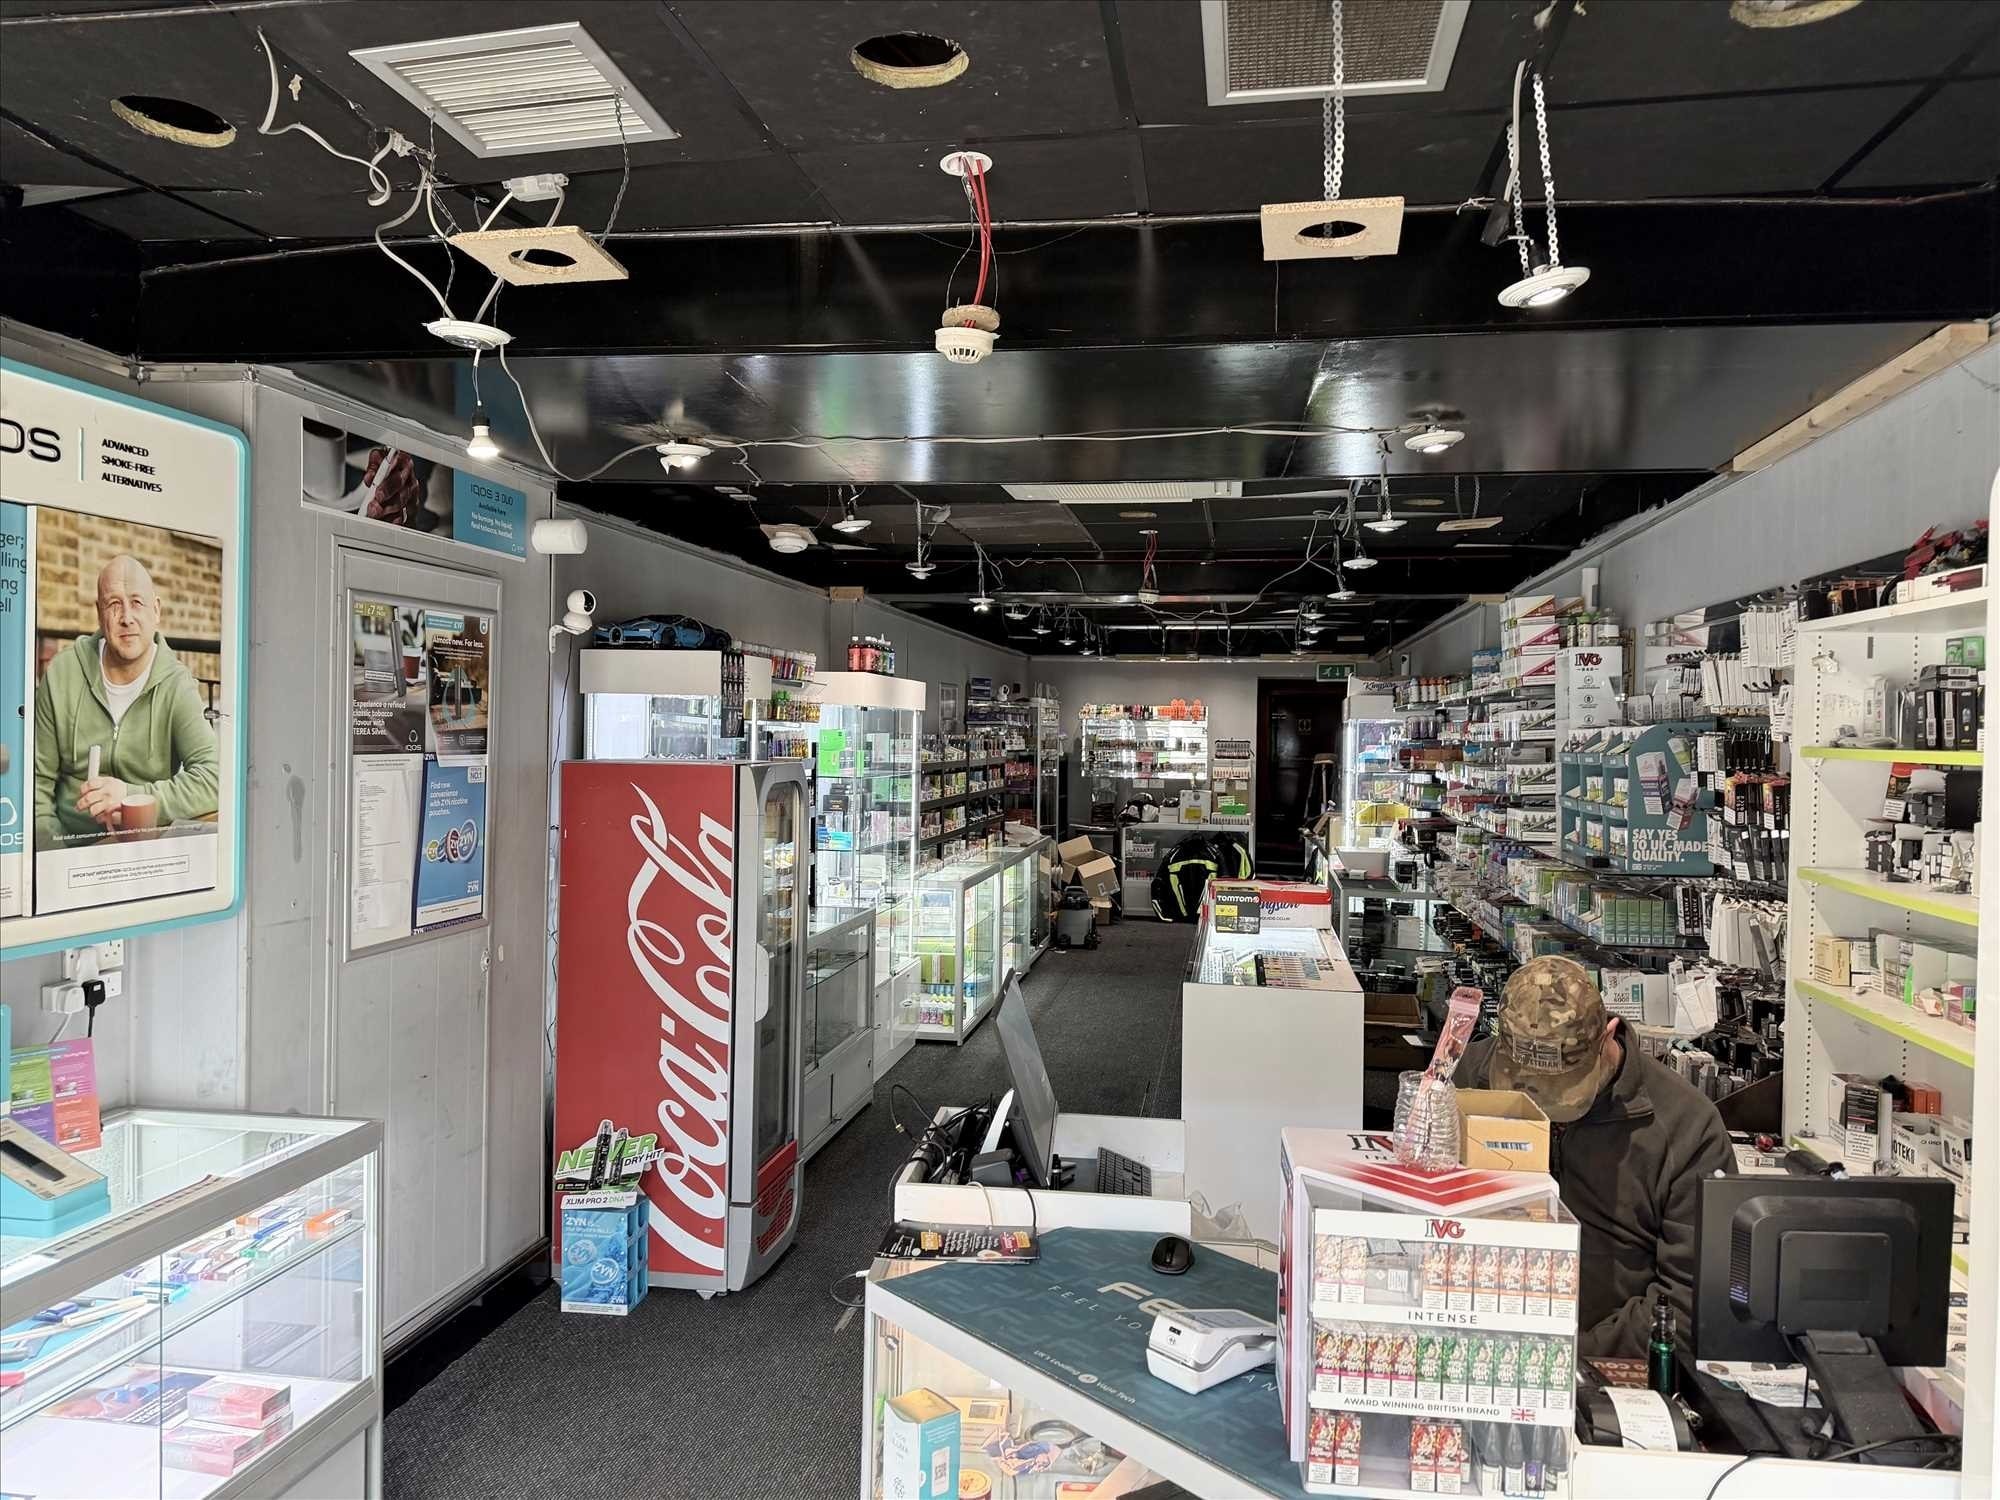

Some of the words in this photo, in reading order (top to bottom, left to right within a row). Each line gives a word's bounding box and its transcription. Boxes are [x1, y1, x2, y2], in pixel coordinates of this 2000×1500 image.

[101, 438, 150, 458] ADVANCED
[101, 455, 156, 476] SMOKE-FREE
[101, 472, 163, 493] ALTERNATIVES
[471, 483, 493, 499] IQOS
[494, 491, 500, 502] 3
[432, 634, 451, 646] Almost
[451, 638, 464, 646] new.
[464, 638, 473, 647] For
[473, 639, 484, 649] less.
[1575, 652, 1602, 667] IVG
[352, 699, 382, 709] Experience
[387, 701, 406, 709] refined
[352, 709, 371, 718] classic
[353, 718, 372, 727] flavour
[372, 718, 385, 727] with
[352, 727, 371, 735] TEREA
[459, 831, 474, 848] ZYN
[1632, 828, 1655, 841] SAY
[1657, 829, 1678, 841] YES
[1632, 839, 1648, 850] TO
[1650, 840, 1708, 852] UK-MADE
[1632, 850, 1685, 863] QUALITY.
[627, 781, 735, 1271] Coca-Cola
[559, 1134, 658, 1170] NEVER
[624, 1154, 644, 1167] DRY
[644, 1150, 663, 1161] HIT
[608, 1196, 625, 1204] DNA
[565, 1217, 587, 1226] ZYN
[1424, 1218, 1465, 1240] IVG
[594, 1262, 616, 1280] ZYN
[610, 1296, 625, 1304] ZYN
[1048, 1285, 1101, 1312] FEEL
[1408, 1310, 1478, 1325] INTENSE
[1344, 1397, 1379, 1408] AWARD
[1381, 1399, 1425, 1411] WINNING
[1427, 1402, 1464, 1414] BRITISH
[1467, 1406, 1500, 1417] BRAND
